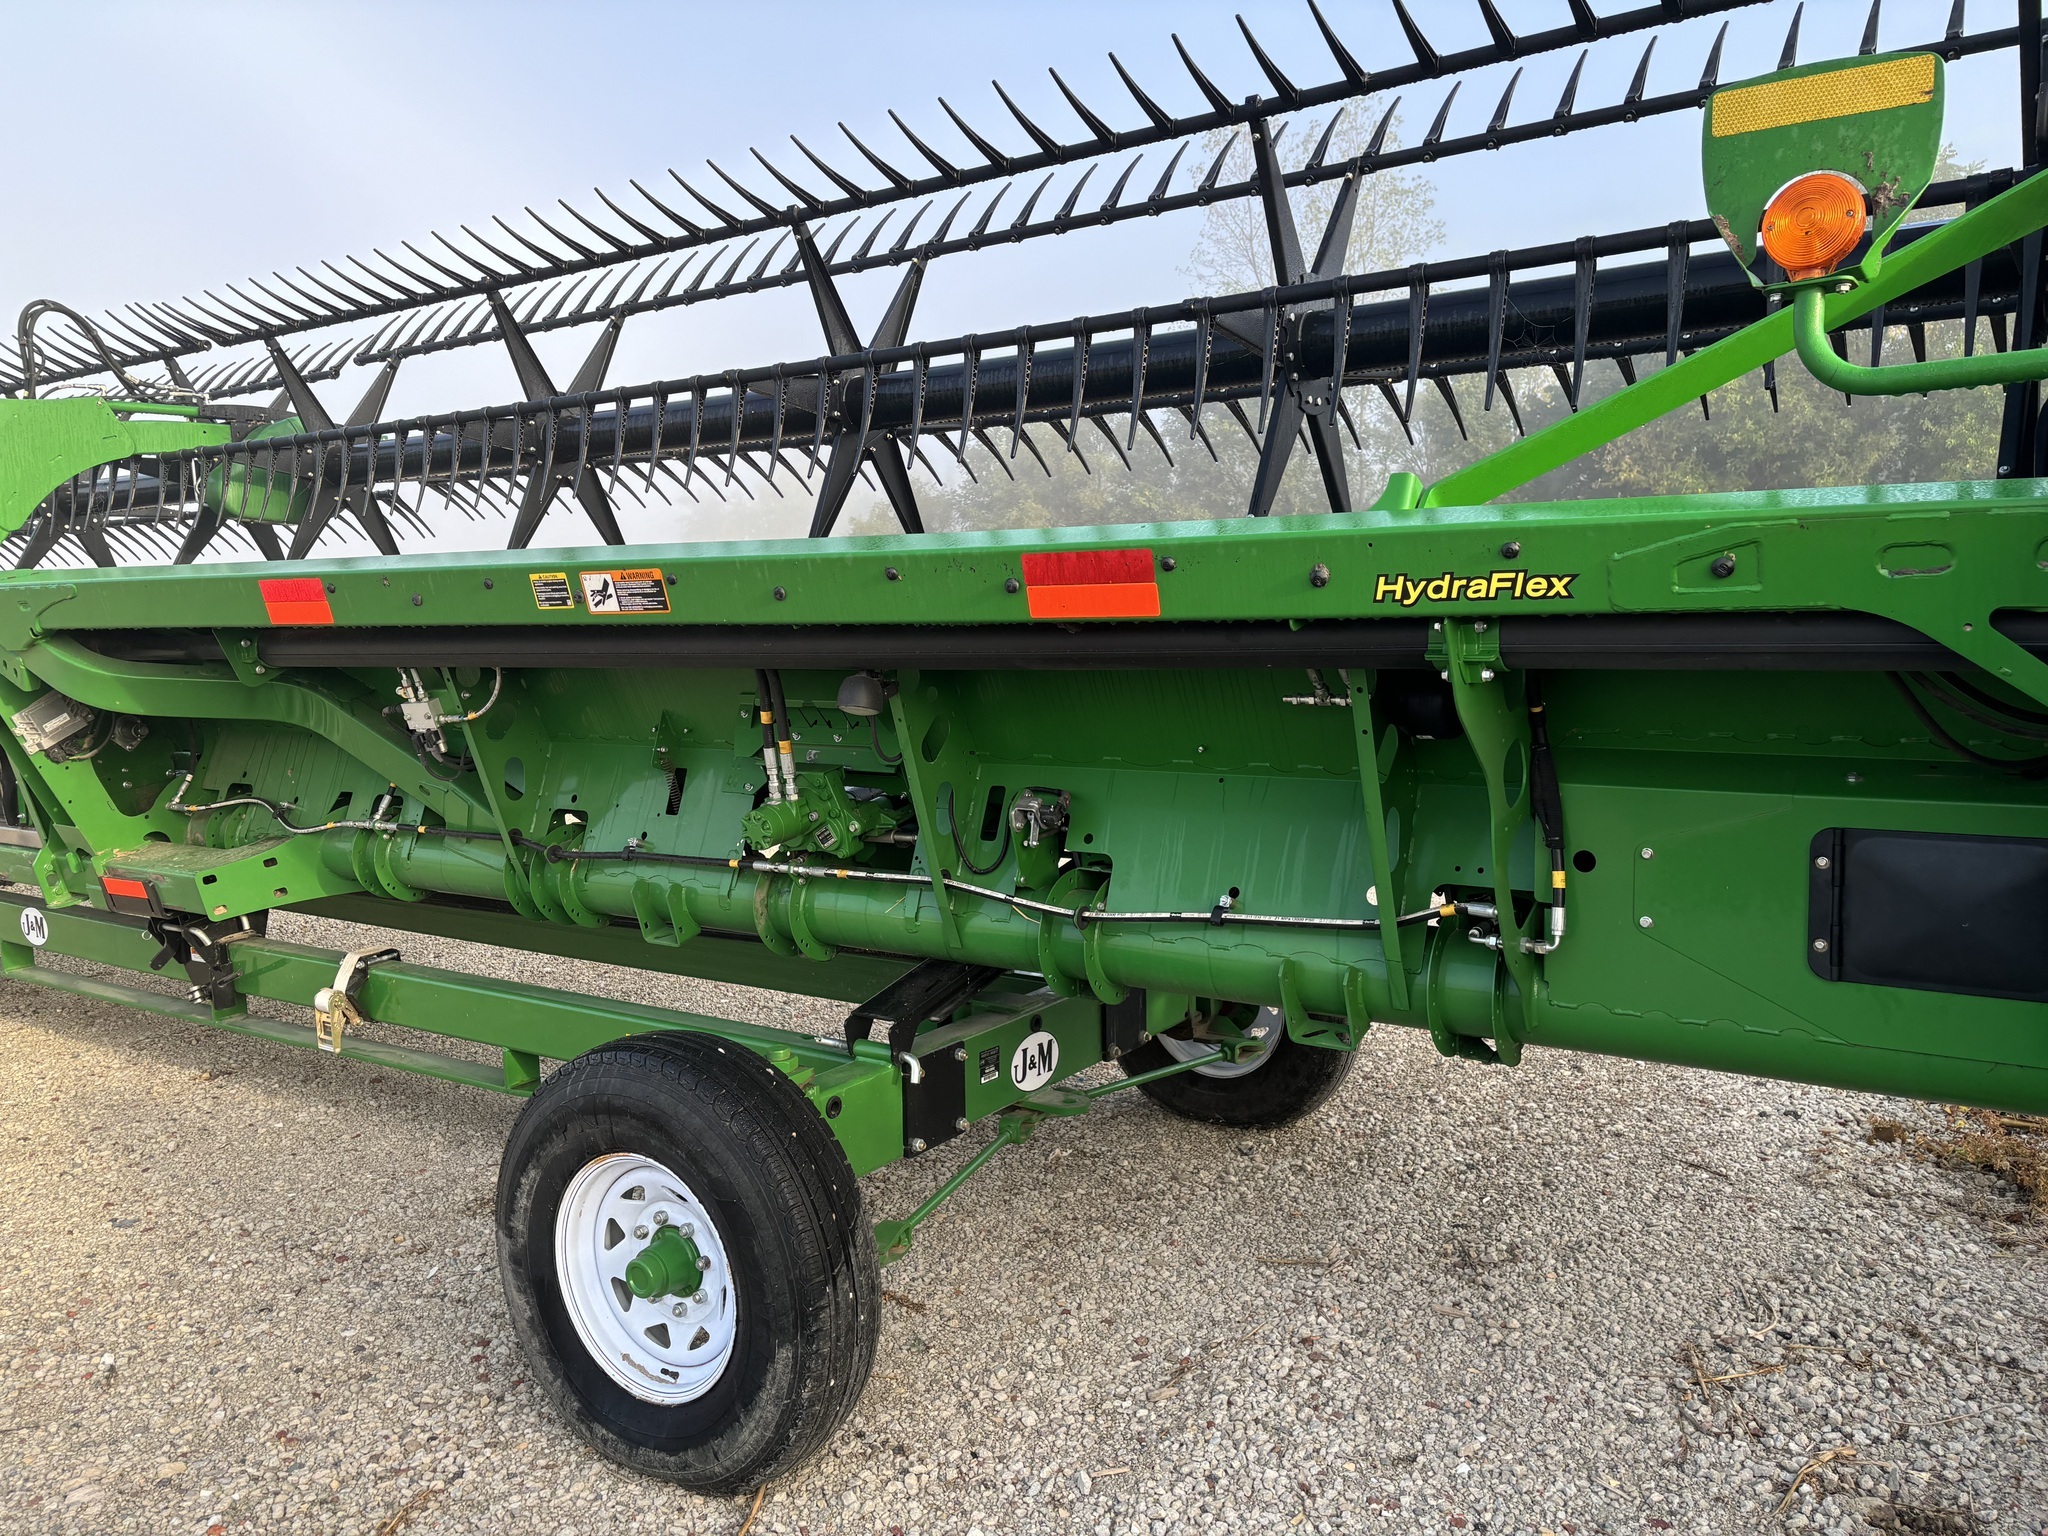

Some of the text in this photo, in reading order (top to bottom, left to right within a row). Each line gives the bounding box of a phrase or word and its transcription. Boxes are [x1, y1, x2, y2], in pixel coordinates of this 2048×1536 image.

[626, 571, 655, 580] WARNING
[1375, 571, 1573, 605] HydraFlex
[22, 913, 46, 940] J&M
[1013, 1038, 1054, 1084] J&M
